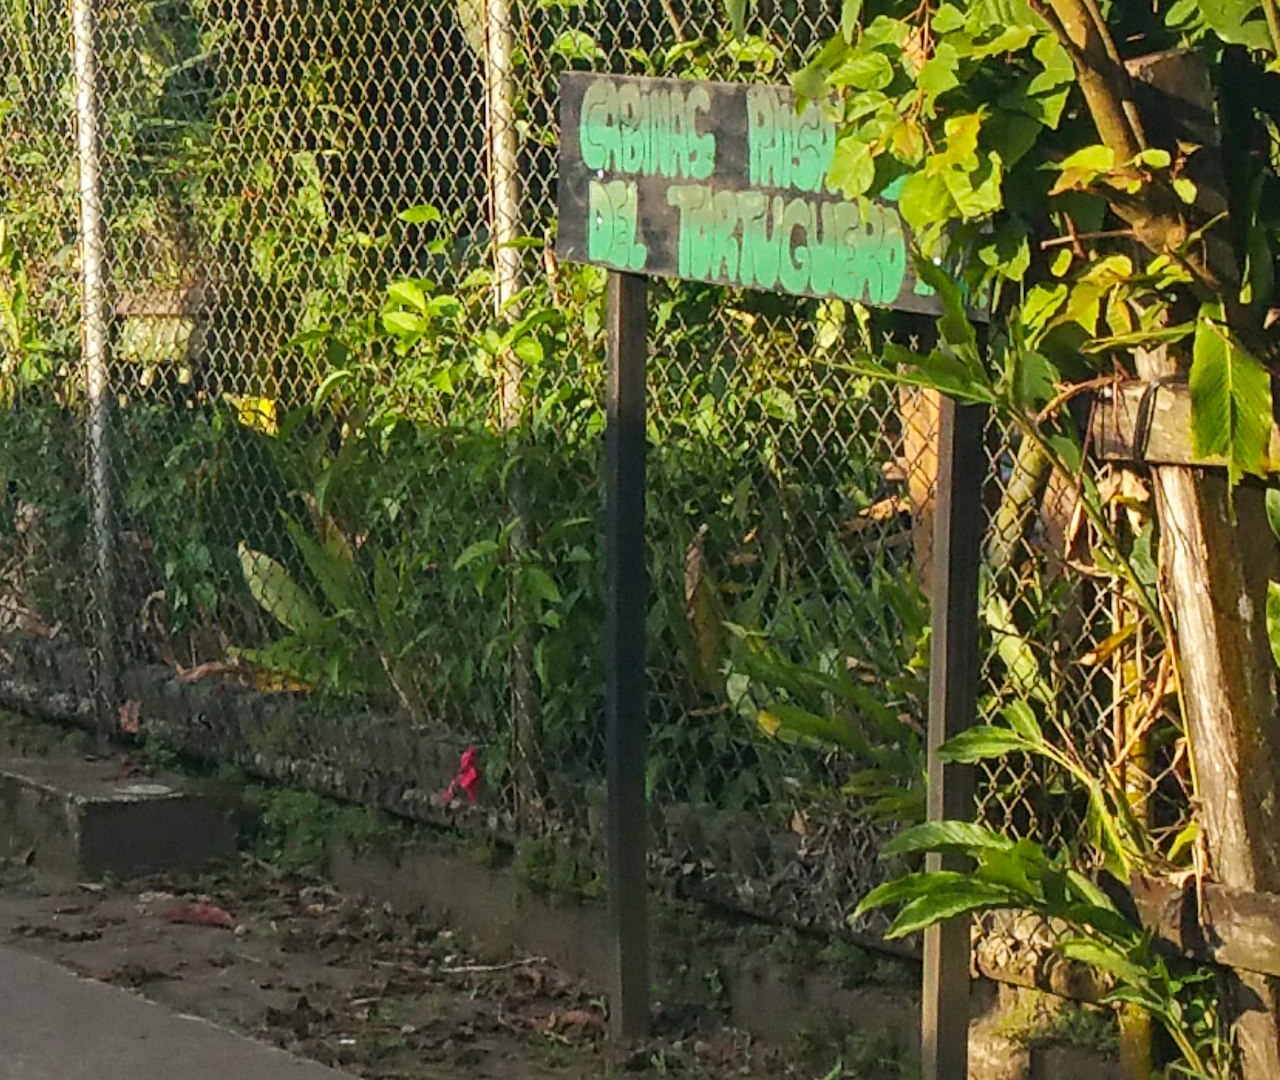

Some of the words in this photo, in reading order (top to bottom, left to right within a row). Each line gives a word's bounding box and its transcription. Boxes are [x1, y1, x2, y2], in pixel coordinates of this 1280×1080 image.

[579, 79, 716, 180] CABINAS
[588, 179, 648, 270] DEL
[666, 184, 906, 305] TORTUGUERO
